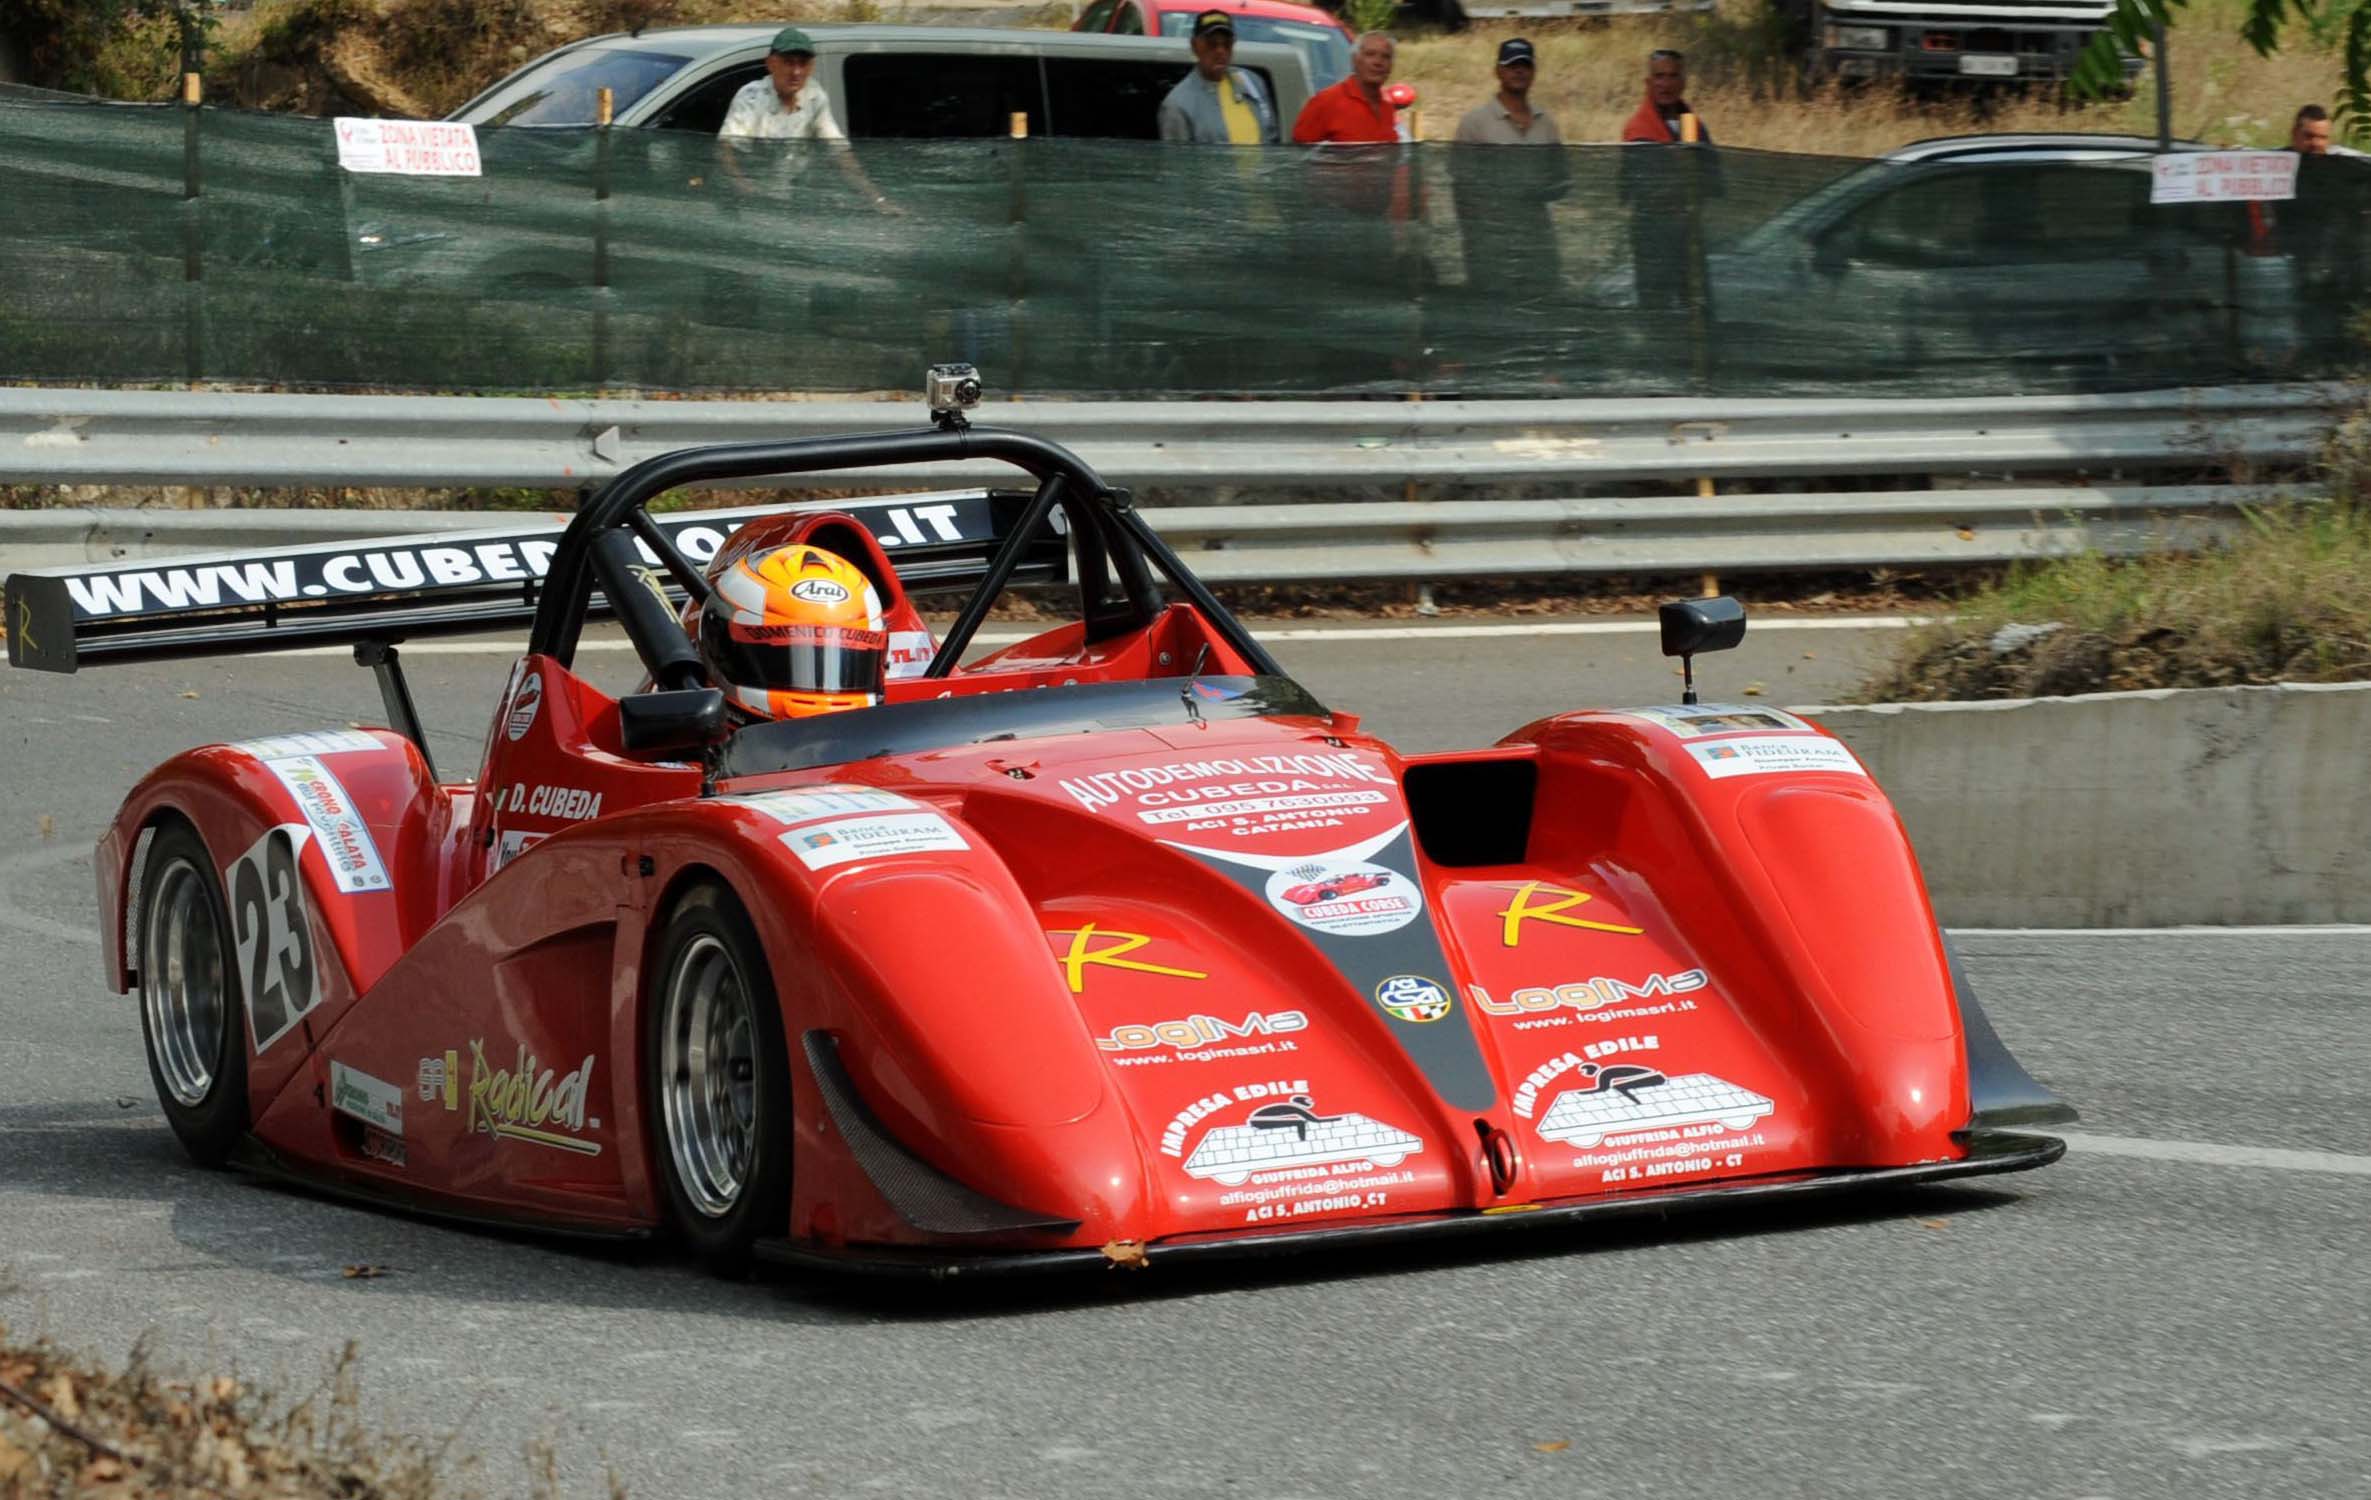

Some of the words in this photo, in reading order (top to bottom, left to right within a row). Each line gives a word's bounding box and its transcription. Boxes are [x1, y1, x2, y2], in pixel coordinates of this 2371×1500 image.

[803, 580, 843, 598] Arai
[1058, 753, 1397, 814] AUTODEMOLIZIONE
[1137, 779, 1321, 805] CUBEDA
[508, 783, 526, 813] D.
[528, 785, 603, 820] CUBEDA
[1203, 801, 1256, 814] 095
[836, 825, 887, 836] Banca
[1186, 819, 1228, 831] ACI
[1231, 816, 1257, 826] S.
[1263, 806, 1371, 823] ANTONIO
[1231, 817, 1344, 836] CATANIA
[1304, 902, 1360, 918] CUBEDA
[1360, 896, 1405, 911] CORSE
[234, 828, 314, 1047] 23
[1512, 1052, 1584, 1119] IMPRESA
[1583, 1035, 1660, 1060] EDILE
[1160, 1092, 1233, 1158] IMPRESA
[1233, 1079, 1310, 1101] EDILE
[1603, 1128, 1680, 1147] GIUFFRIDA
[1682, 1123, 1725, 1139] ALFIO
[1572, 1132, 1766, 1168] alfiogiuffrida@hotmail.it
[1250, 1166, 1329, 1185] GIUFFRIDA
[1331, 1161, 1375, 1175] ALFIO
[1601, 1167, 1626, 1183] ACI
[1629, 1165, 1643, 1179] S.
[1645, 1157, 1713, 1177] ANTONIO
[1726, 1153, 1744, 1167] CT
[1219, 1170, 1415, 1206] alfiogiuffrida@hotmail.it
[1245, 1205, 1273, 1222] ACI
[1275, 1203, 1292, 1217] S.
